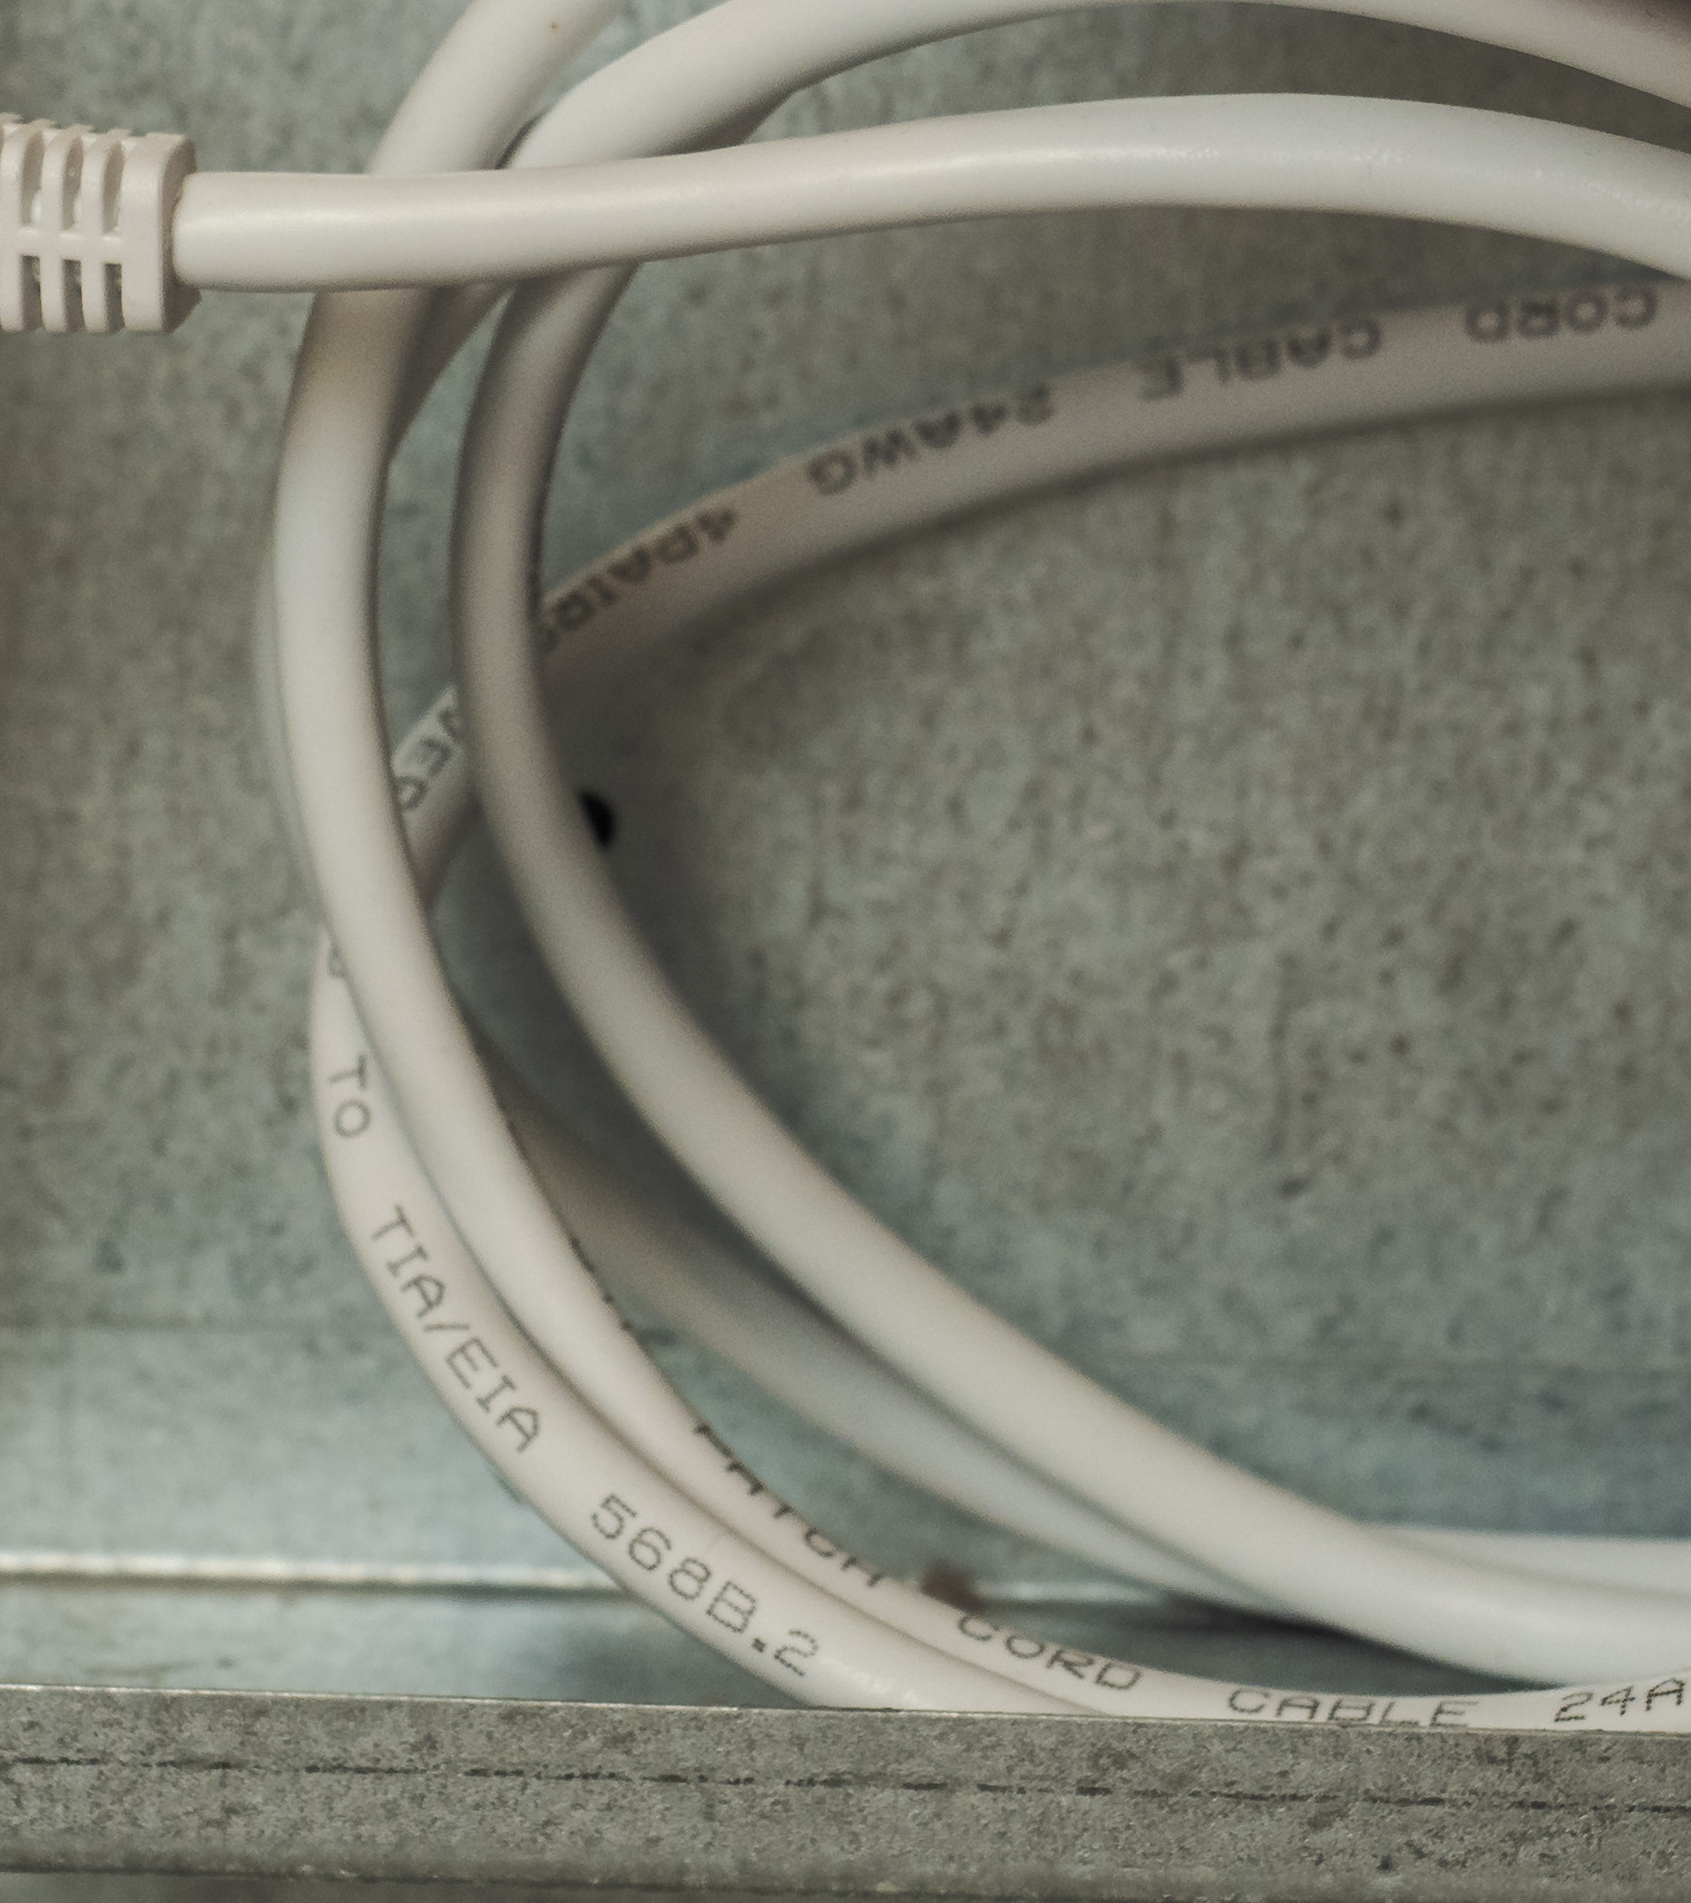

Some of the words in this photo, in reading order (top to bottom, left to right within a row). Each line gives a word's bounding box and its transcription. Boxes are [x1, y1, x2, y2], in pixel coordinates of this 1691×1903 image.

[1141, 318, 1381, 401] CABLE
[1464, 285, 1657, 343] CORD
[809, 384, 1054, 495] 24AWG
[329, 1054, 373, 1139] TO
[371, 1203, 543, 1454] TIA/EIA
[589, 1493, 820, 1678] 568B.2
[957, 1614, 1144, 1691] CORD
[1227, 1688, 1479, 1727] CABLE
